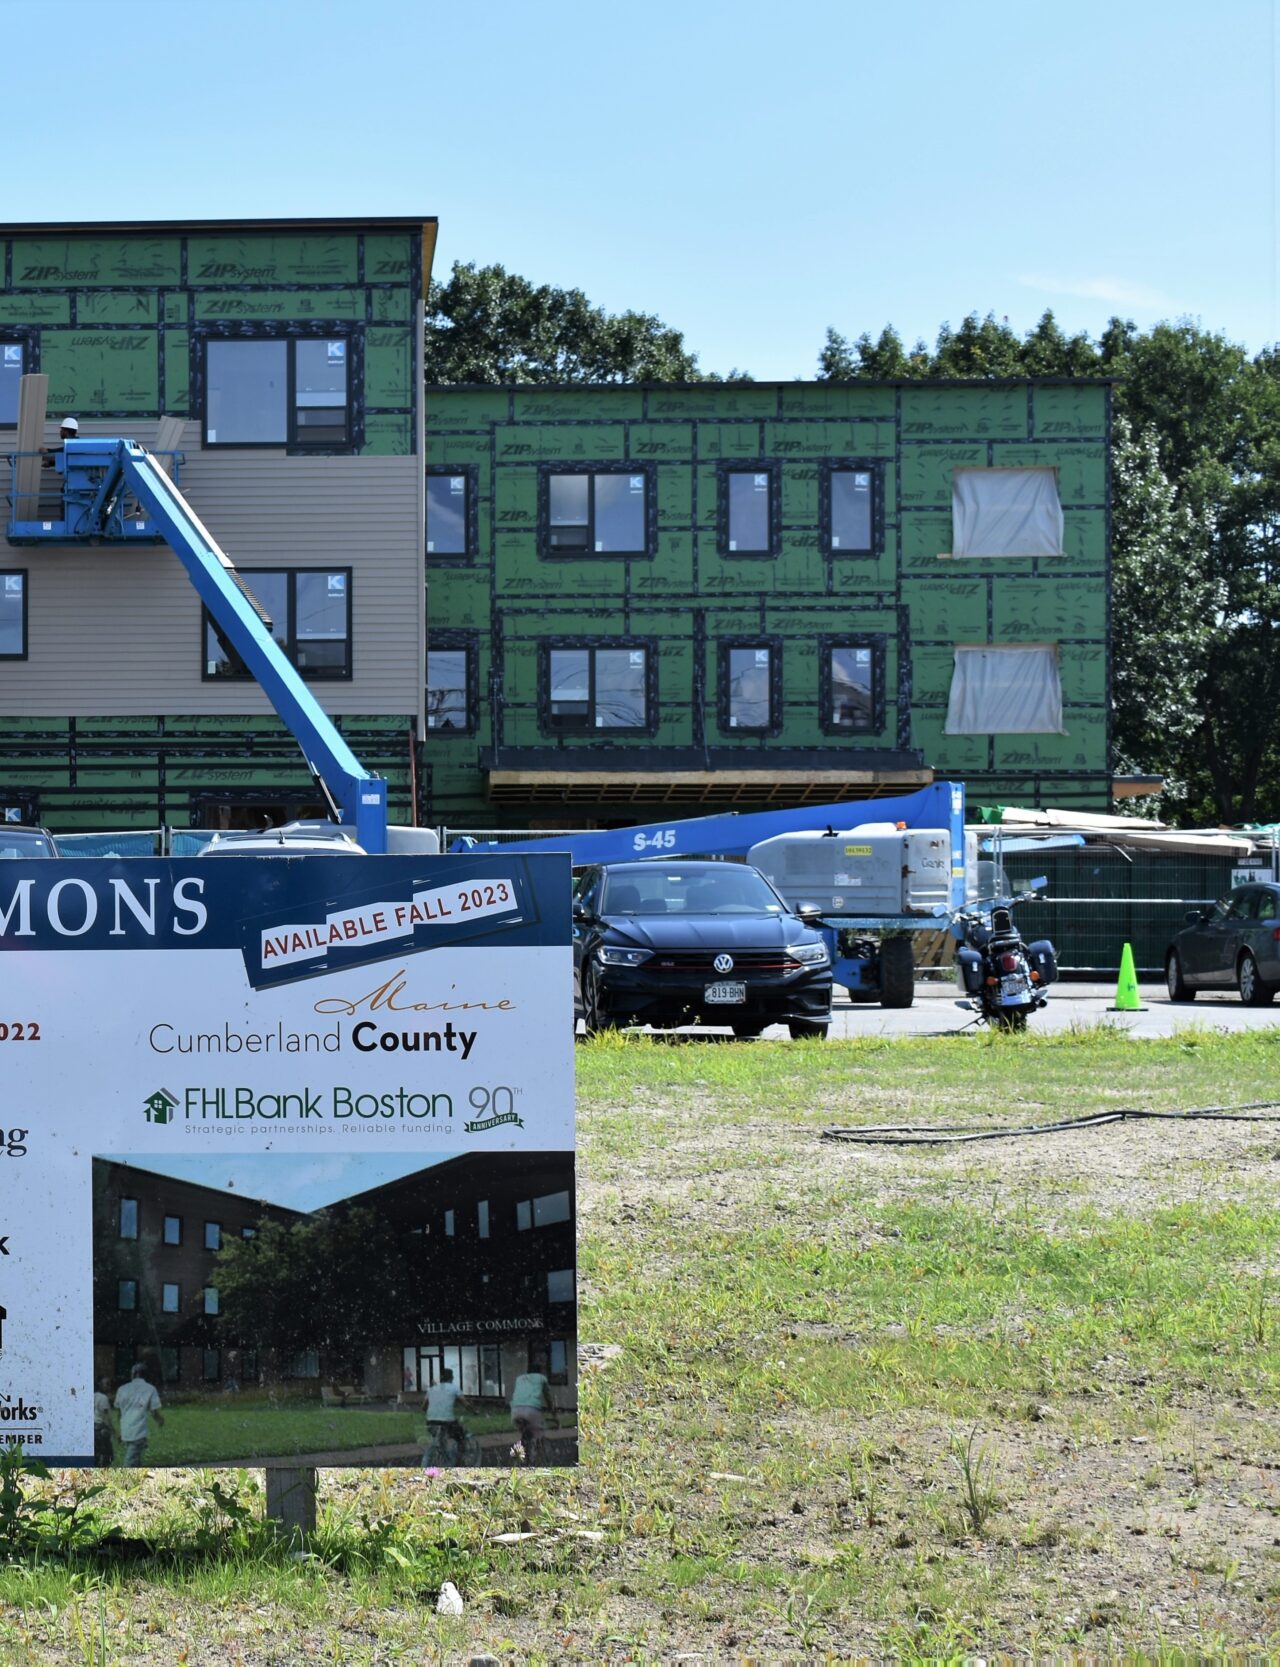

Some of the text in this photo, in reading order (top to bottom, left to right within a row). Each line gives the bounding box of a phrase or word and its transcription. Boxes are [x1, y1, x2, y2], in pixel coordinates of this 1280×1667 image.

[633, 830, 677, 851] S-45
[263, 881, 511, 960] AVAILABLE FALL 2023
[313, 969, 517, 1015] Maine
[149, 1021, 477, 1060] Cumberland County
[185, 1086, 454, 1119] FHLBank Boston
[185, 1122, 456, 1136] Strategic partnerships. Reliable funding.
[471, 1112, 517, 1132] ANNIVERSARY
[418, 1318, 545, 1334] VILLAGE COMMONS
